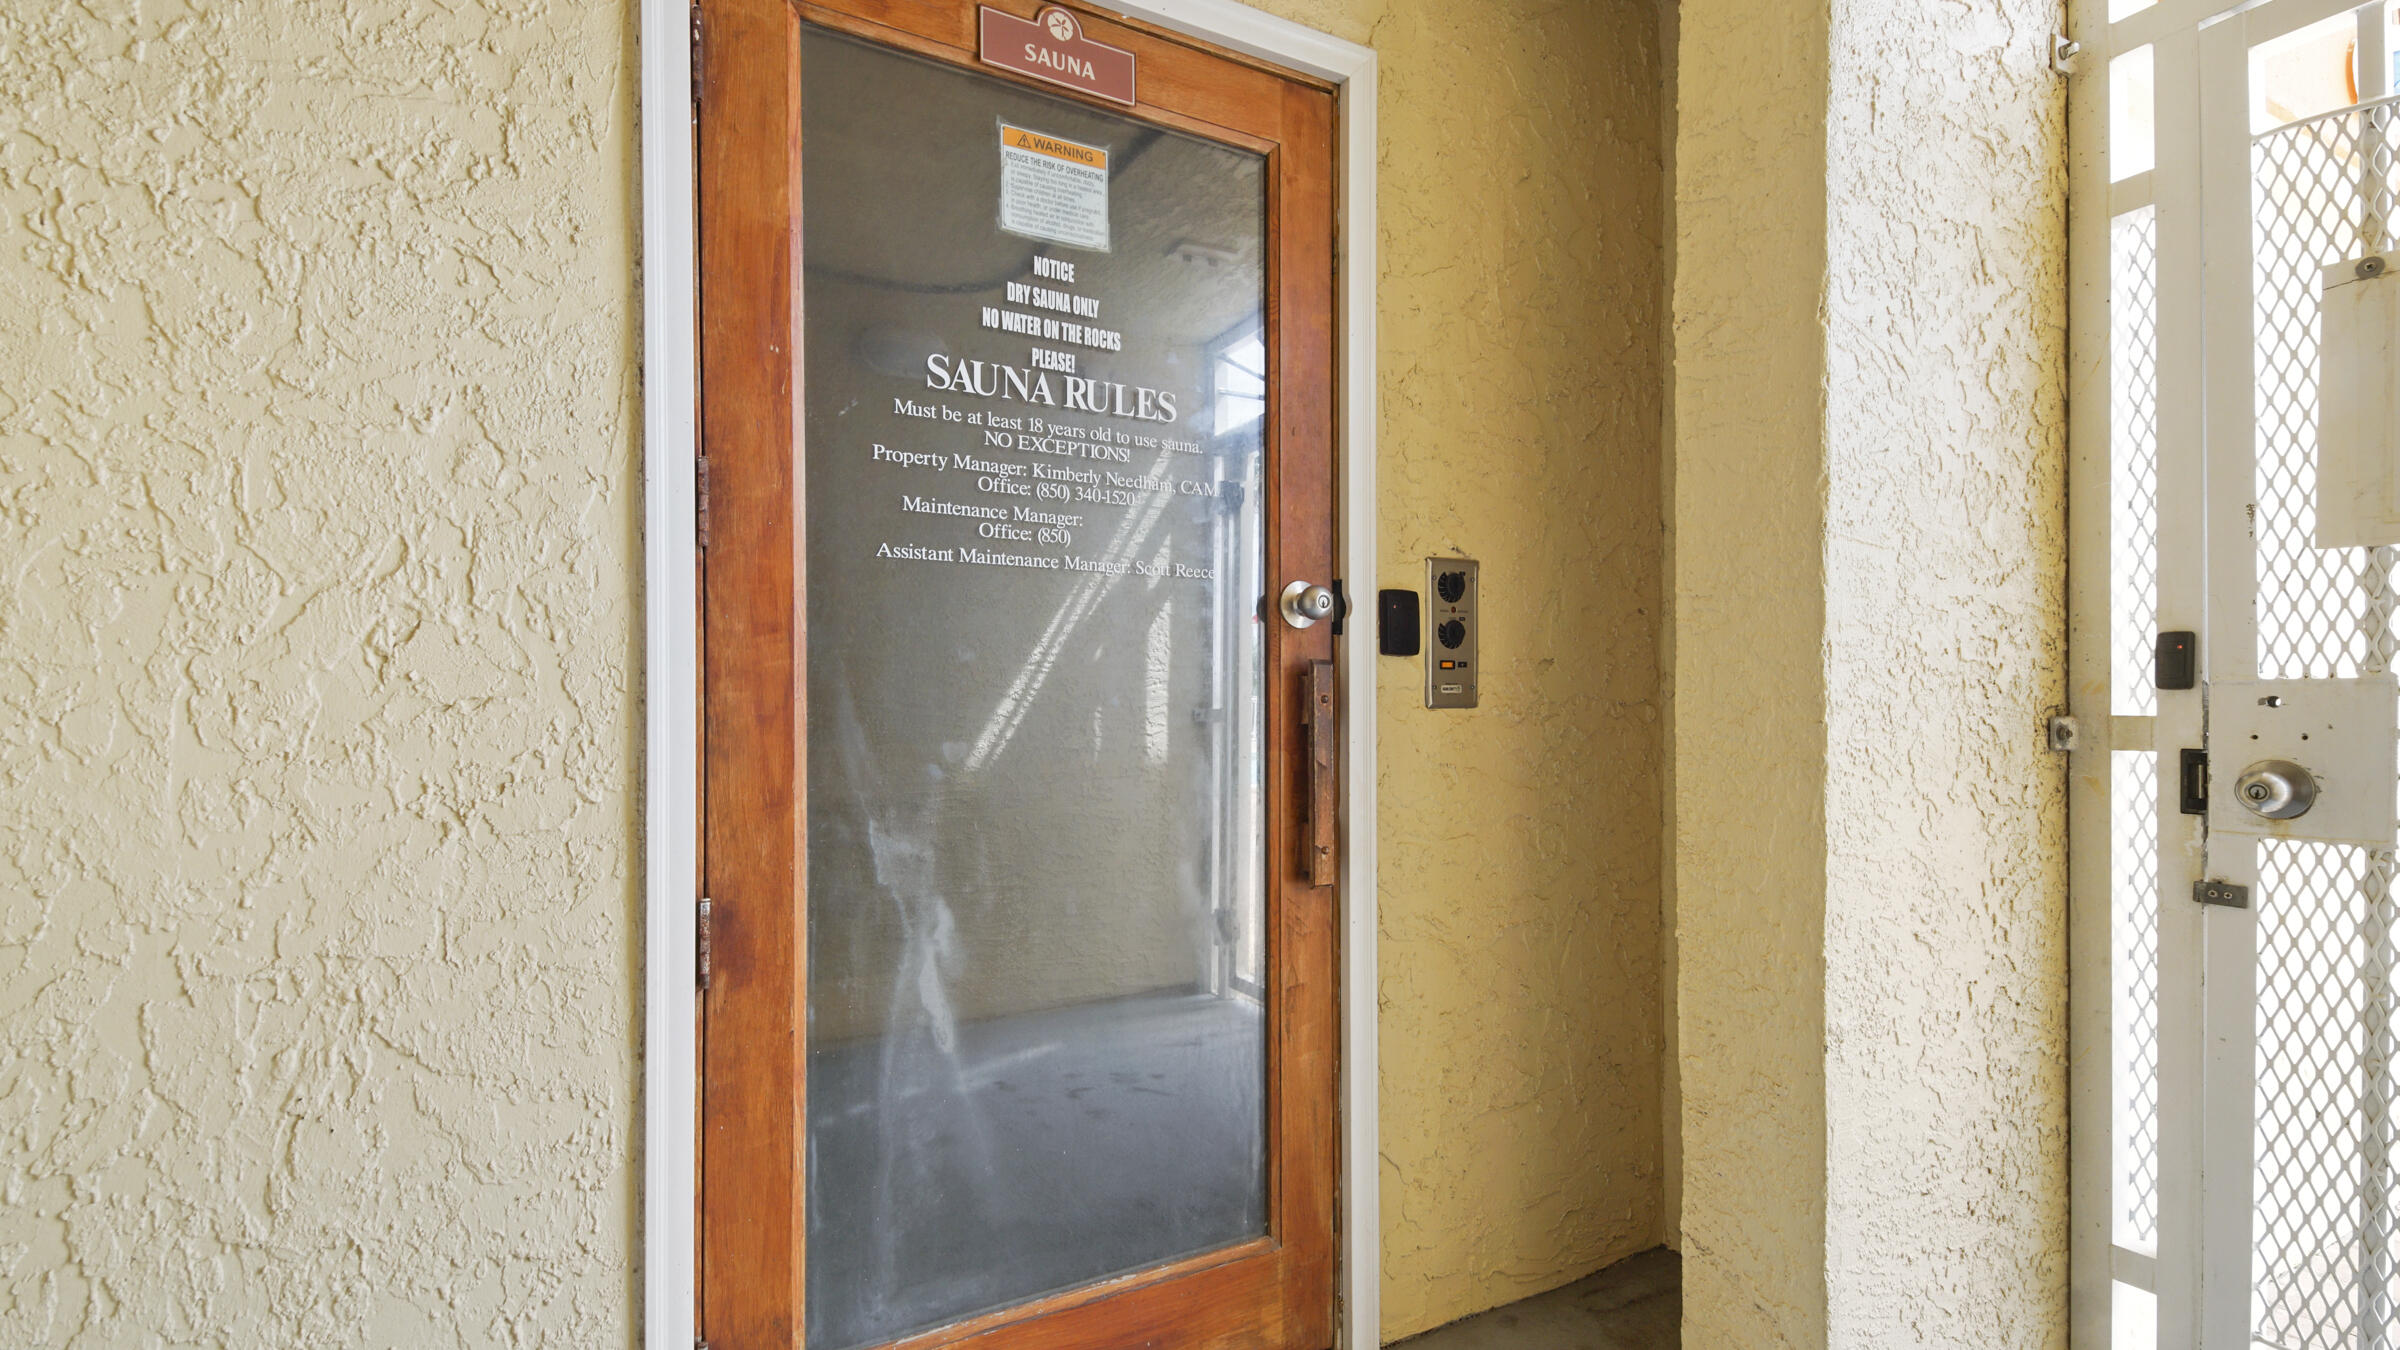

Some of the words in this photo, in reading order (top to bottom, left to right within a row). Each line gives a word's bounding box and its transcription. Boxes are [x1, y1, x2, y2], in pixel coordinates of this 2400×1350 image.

[1024, 43, 1096, 80] SAUNA
[1034, 137, 1093, 162] WARNING
[1006, 151, 1029, 164] REDUCE
[1030, 156, 1040, 167] THE
[1043, 160, 1056, 171] RISK
[1057, 163, 1065, 172] OF
[1066, 166, 1103, 182] OVERHEATING
[1034, 256, 1074, 283] NOTICE
[1007, 282, 1031, 304] DRY
[1032, 287, 1071, 313] SAUNA
[1073, 296, 1100, 318] ONLY
[982, 306, 999, 328] NO
[1002, 310, 1042, 337] WATER
[1044, 318, 1059, 340] ON
[1062, 322, 1082, 344] THE
[1084, 325, 1121, 351] ROCKS
[1032, 348, 1075, 373] PLEASE!
[926, 353, 1055, 406] SAUNA
[1064, 375, 1177, 423] RULES
[894, 398, 936, 419] Must
[942, 405, 962, 422] be
[968, 412, 982, 425] at
[988, 412, 1022, 430] least
[1028, 417, 1043, 432] 18
[1048, 422, 1086, 443] years
[1090, 426, 1111, 442] old
[1116, 431, 1130, 444] to
[1134, 435, 1157, 448] use
[1162, 438, 1203, 454] sauna.
[984, 430, 1012, 448] NO
[1018, 435, 1130, 462] EXCEPTIONS!
[872, 444, 948, 472] Property
[953, 454, 1027, 478] Manager:
[1032, 463, 1101, 488] Kimberly
[1106, 472, 1176, 494] Needham,
[1180, 480, 1218, 497] CAM
[978, 476, 1031, 496] Office:
[1036, 482, 1070, 504] (850)
[1075, 486, 1135, 506] 340-1520
[902, 496, 1008, 520] Maintenance
[1013, 506, 1083, 528] Manager:
[979, 523, 1032, 541] Office:
[1038, 527, 1071, 548] (850)
[876, 542, 954, 562] Assistant
[959, 548, 1059, 569] Maintenance
[1064, 555, 1131, 578] Manager:
[1136, 560, 1170, 576] Scott
[1175, 564, 1216, 579] Reece
